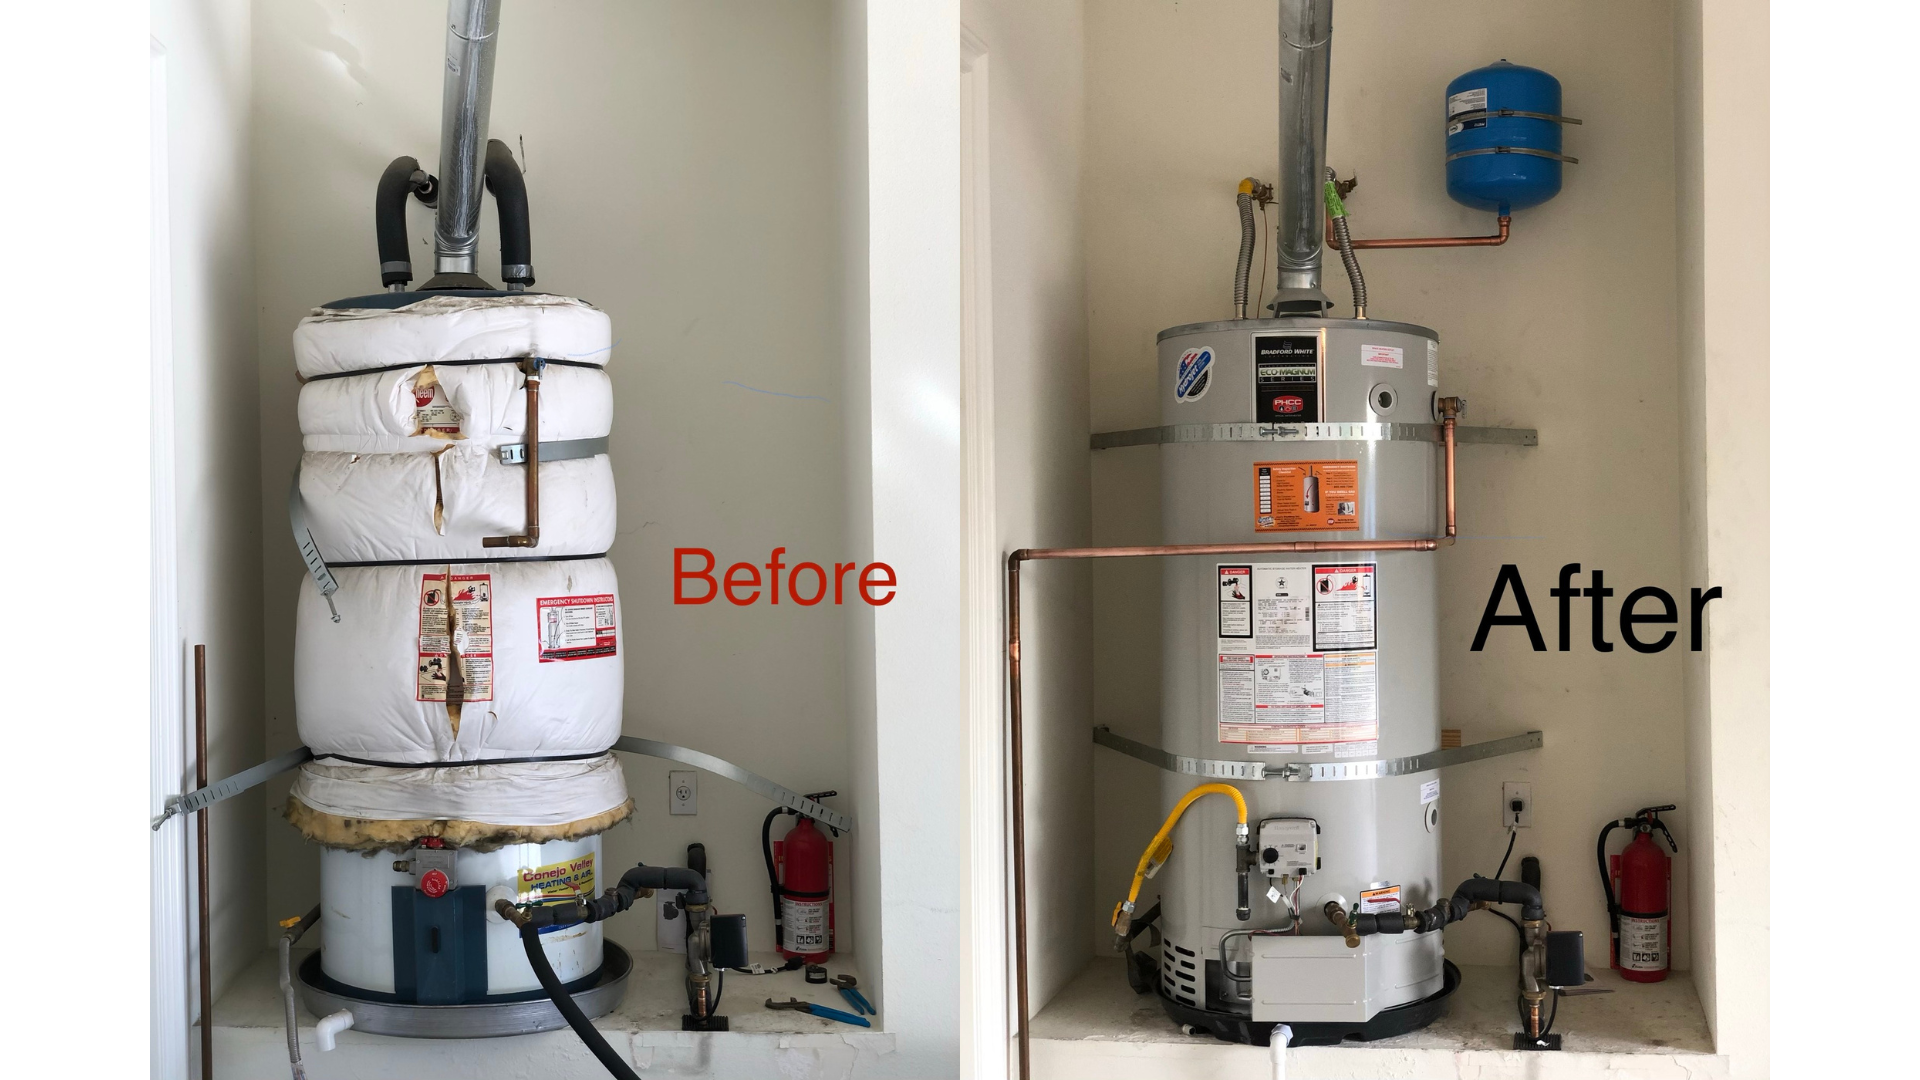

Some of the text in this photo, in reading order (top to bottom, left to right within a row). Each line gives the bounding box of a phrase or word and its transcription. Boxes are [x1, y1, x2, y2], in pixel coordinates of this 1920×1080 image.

[523, 866, 567, 882] Conejo
[569, 859, 594, 873] Valley
[530, 876, 572, 890] HEATING
